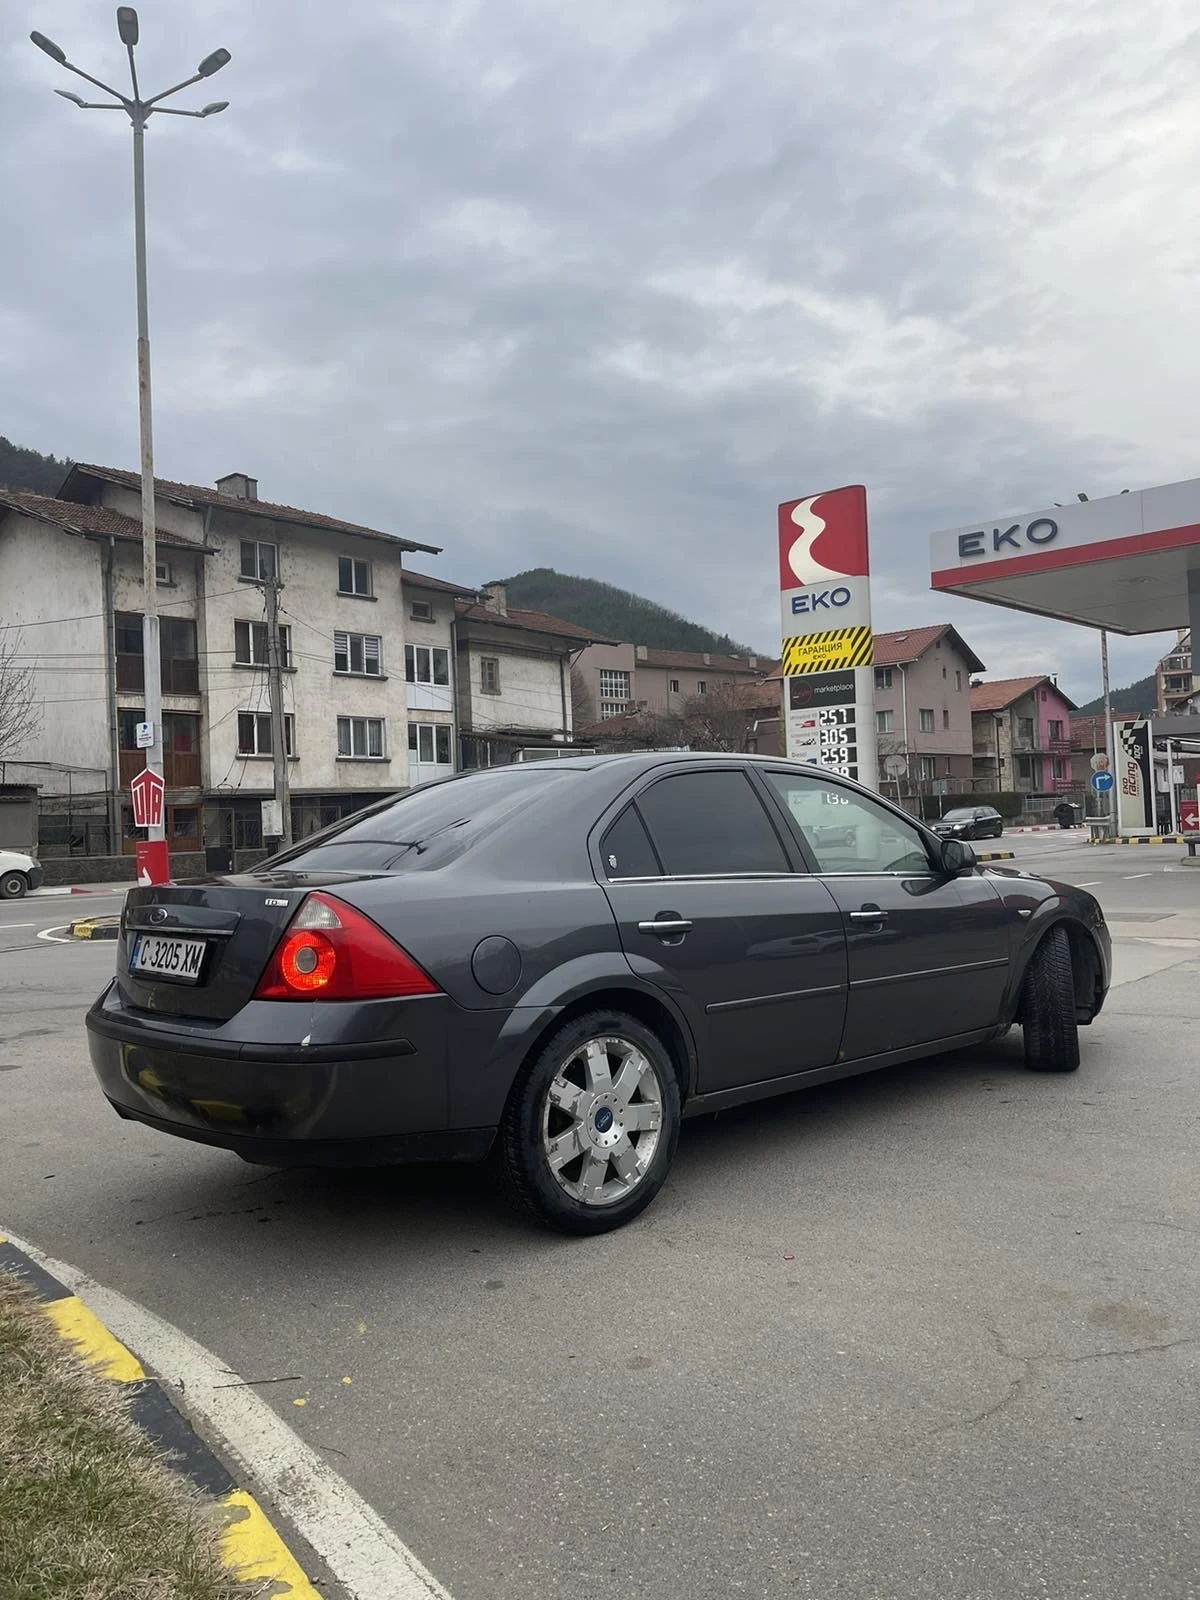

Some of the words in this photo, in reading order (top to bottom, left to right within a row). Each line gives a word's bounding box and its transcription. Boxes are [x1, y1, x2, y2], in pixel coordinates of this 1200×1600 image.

[958, 518, 1058, 557] EKO
[791, 587, 851, 614] EKO
[798, 642, 843, 656] ГАРАНЦИЯ
[814, 683, 854, 694] marketplace
[820, 708, 847, 726] 2.57
[1133, 744, 1141, 759] 100
[1128, 762, 1138, 797] racing
[140, 940, 150, 967] C
[151, 941, 182, 970] 3205
[180, 943, 203, 974] XM
